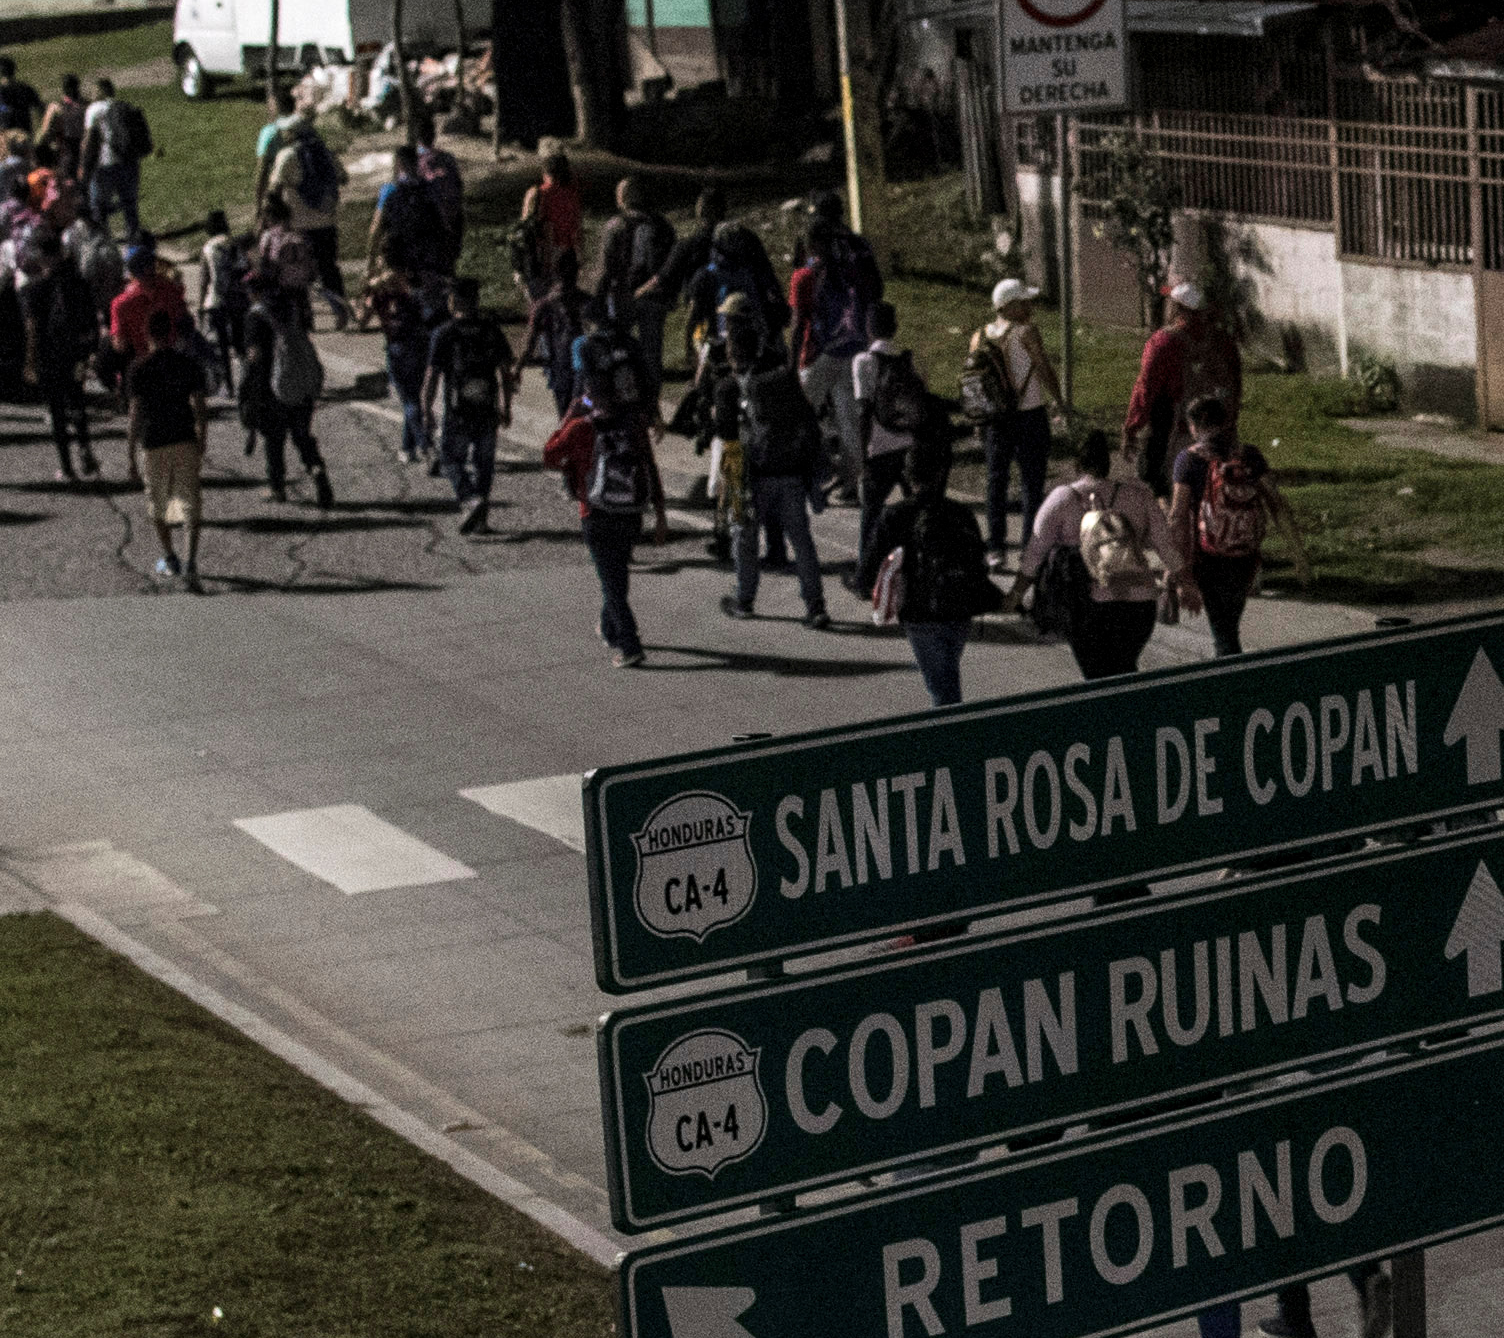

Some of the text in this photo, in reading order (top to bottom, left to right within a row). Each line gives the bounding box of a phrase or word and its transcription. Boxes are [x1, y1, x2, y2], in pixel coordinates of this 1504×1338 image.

[1010, 31, 1116, 54] MANTENGA
[1052, 59, 1076, 77] SU
[1019, 81, 1109, 104] DERECHA
[774, 679, 1419, 899] SANTA ROSA DE COPAN
[648, 816, 737, 851] HONDURAS
[665, 867, 730, 915] CA-4
[785, 903, 1389, 1135] COPAN RUINAS
[659, 1052, 746, 1089] HONDURAS
[676, 1104, 740, 1153] CA-4
